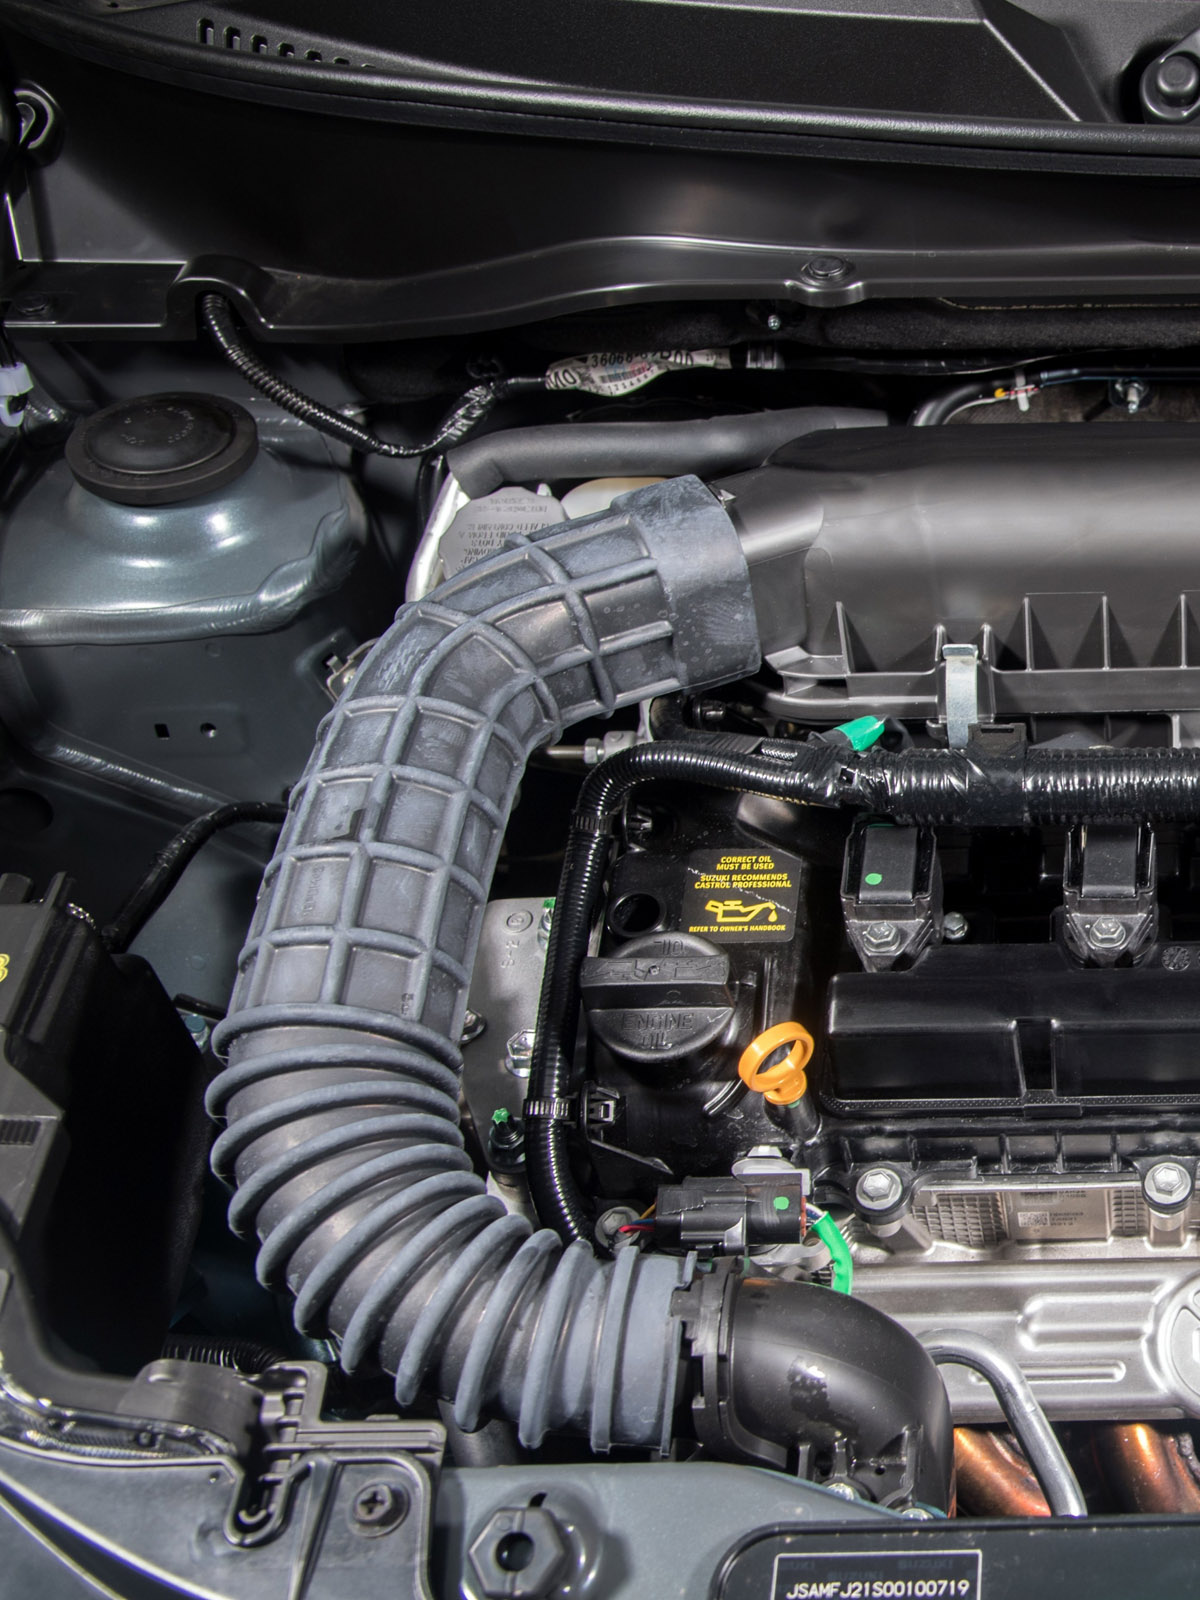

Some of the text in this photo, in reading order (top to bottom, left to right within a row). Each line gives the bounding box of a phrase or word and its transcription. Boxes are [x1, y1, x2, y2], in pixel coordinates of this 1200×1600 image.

[758, 855, 773, 863] OIL
[716, 863, 740, 871] MUST
[753, 862, 775, 870] USED
[700, 873, 788, 882] SUZUKI RECOMMENDS
[694, 880, 792, 889] CASTROL PROFESSIONAL
[749, 924, 786, 932] HANDBOOK
[623, 1012, 695, 1031] ENGINE
[786, 1579, 970, 1599] JSAMFJ21S00100719
